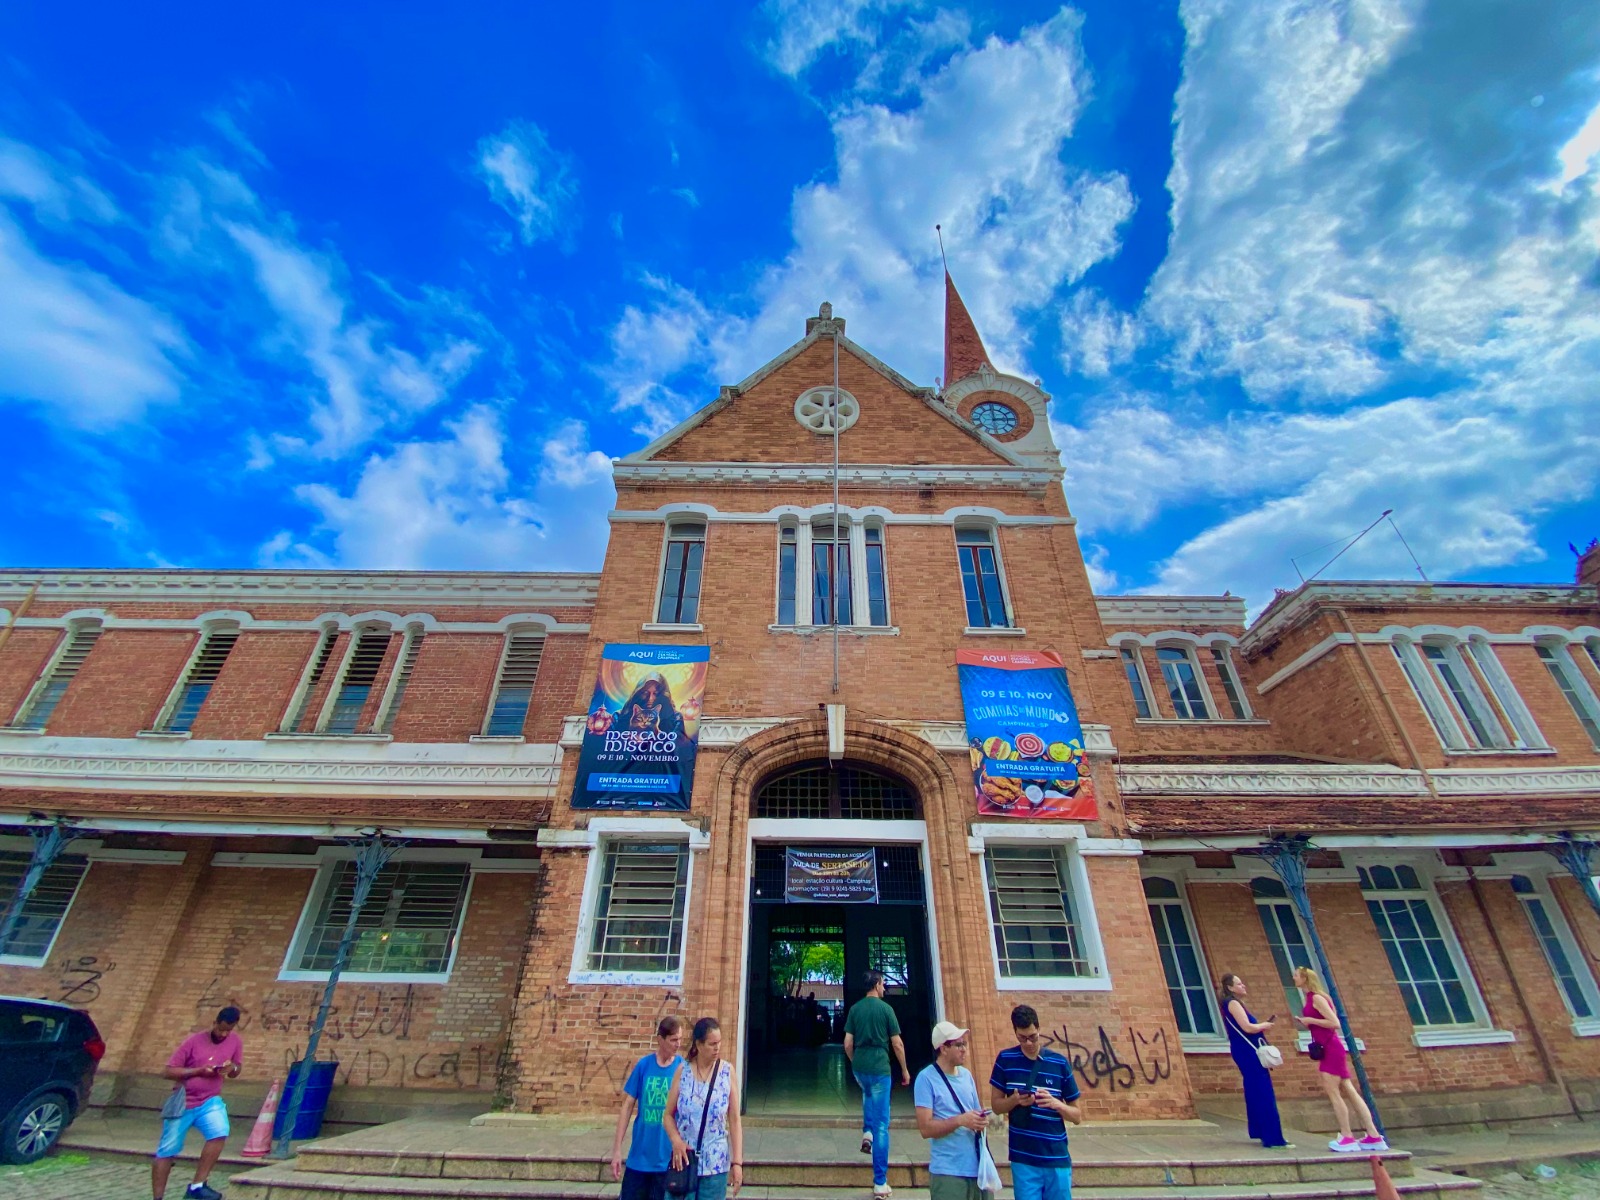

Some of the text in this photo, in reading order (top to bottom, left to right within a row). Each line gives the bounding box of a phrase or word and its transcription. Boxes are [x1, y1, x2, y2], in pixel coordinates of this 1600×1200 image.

[629, 651, 654, 659] AQUI
[982, 655, 1007, 663] AQUI
[981, 690, 995, 698] 09
[999, 690, 1006, 698] E
[1027, 691, 1053, 700] NOV
[973, 705, 1019, 720] COMIDAS
[997, 720, 1035, 728] CAMPINAS
[606, 730, 678, 741] MERCADO
[630, 754, 680, 762] NOVEMBRO
[995, 763, 1066, 773] ENTRADA GRATUITA
[633, 777, 670, 785] GRATUITA
[645, 1076, 669, 1091] HEA
[647, 1090, 668, 1106] VEN
[644, 1108, 664, 1123] DAY
